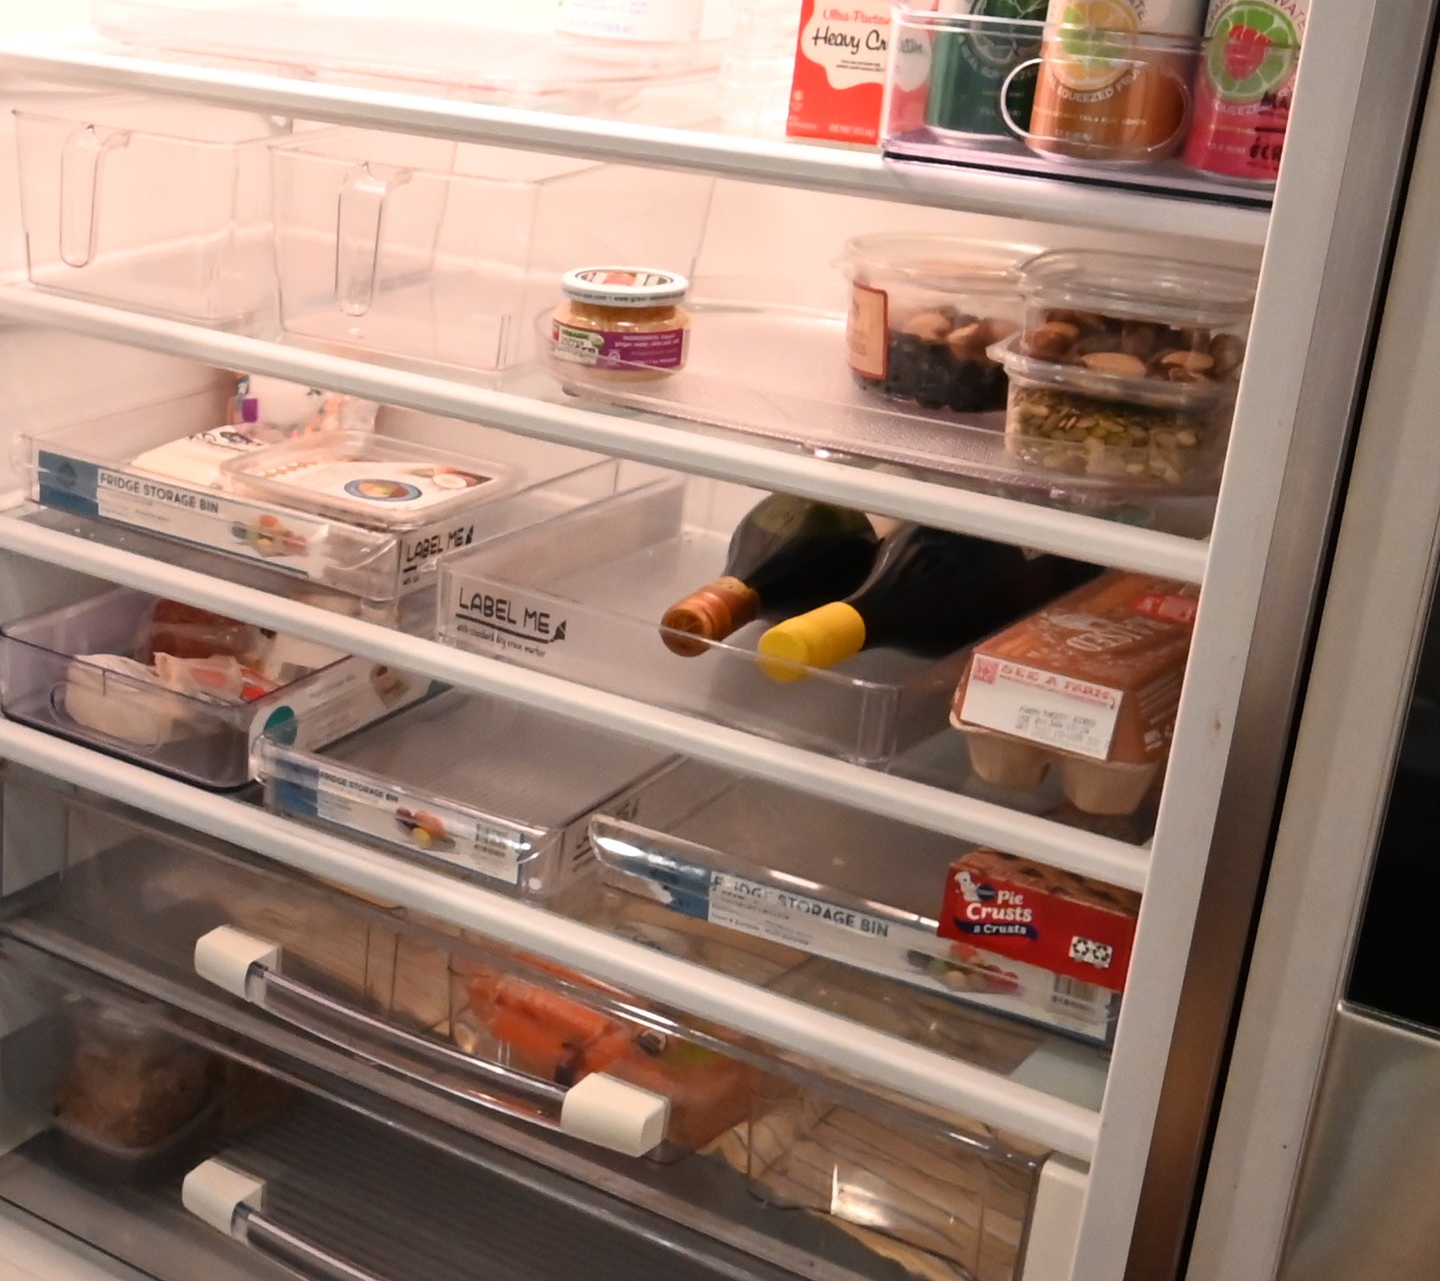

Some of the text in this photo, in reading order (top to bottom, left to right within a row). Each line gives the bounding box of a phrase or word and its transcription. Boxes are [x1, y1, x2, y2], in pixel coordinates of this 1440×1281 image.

[812, 25, 860, 55] Heavy
[100, 472, 219, 514] FRIDGE STORAGE BIN
[407, 527, 465, 562] LABEL ME
[459, 587, 551, 635] LABEL ME
[966, 903, 1033, 922] Crusts
[997, 890, 1024, 905] Pie
[777, 892, 889, 938] STORAGE BIN
[984, 924, 1027, 936] Crusts
